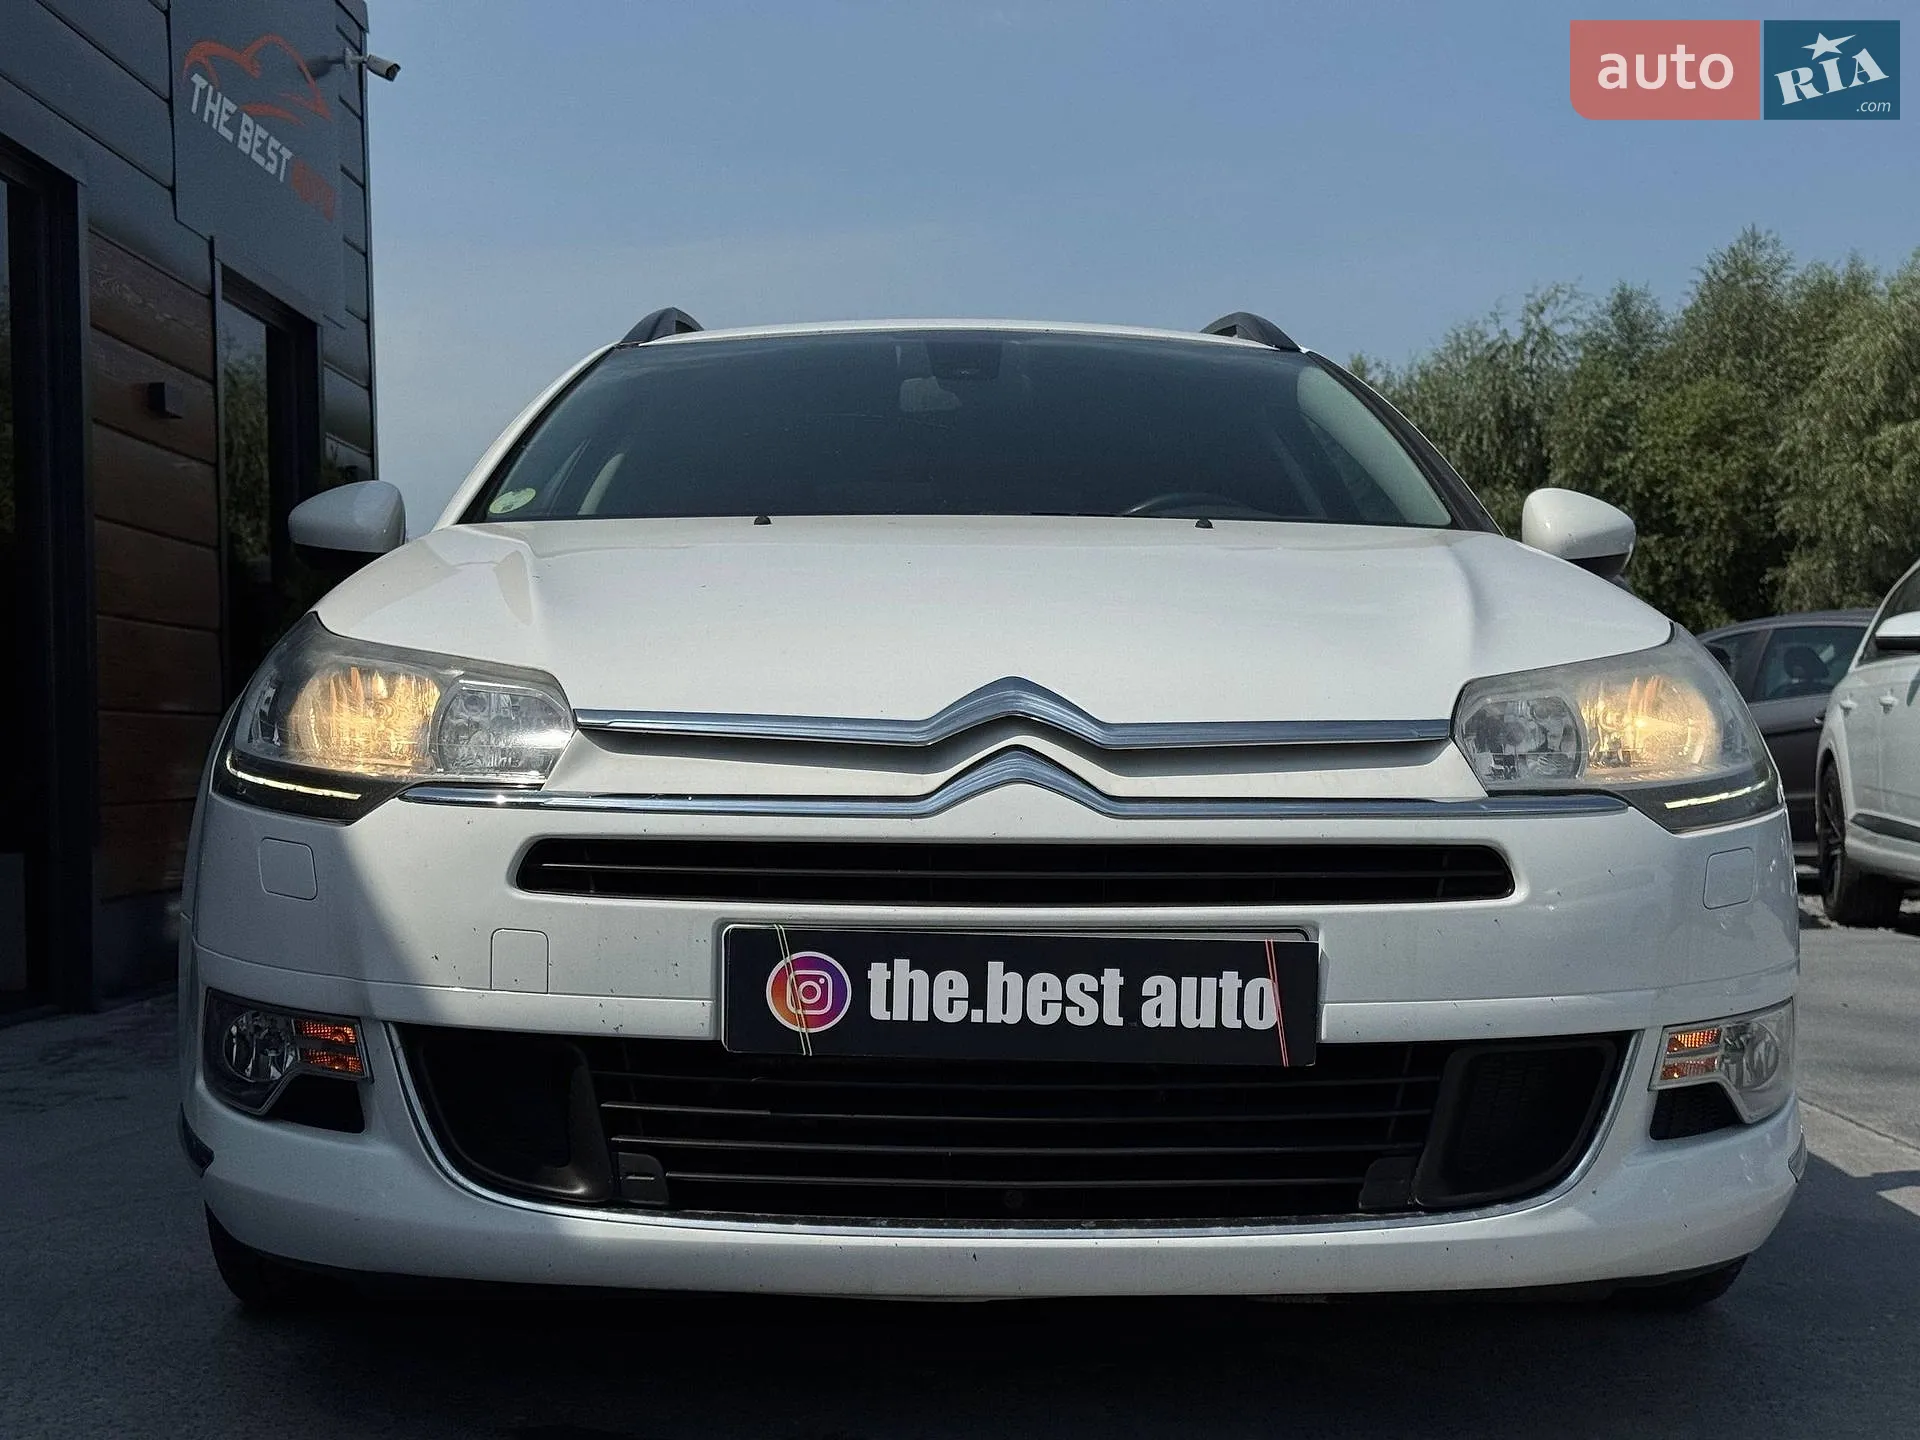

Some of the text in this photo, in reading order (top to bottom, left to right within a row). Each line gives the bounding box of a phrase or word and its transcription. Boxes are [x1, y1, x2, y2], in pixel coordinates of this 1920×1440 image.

[190, 72, 294, 183] THE BEST
[867, 958, 1279, 1031] the.best auto
